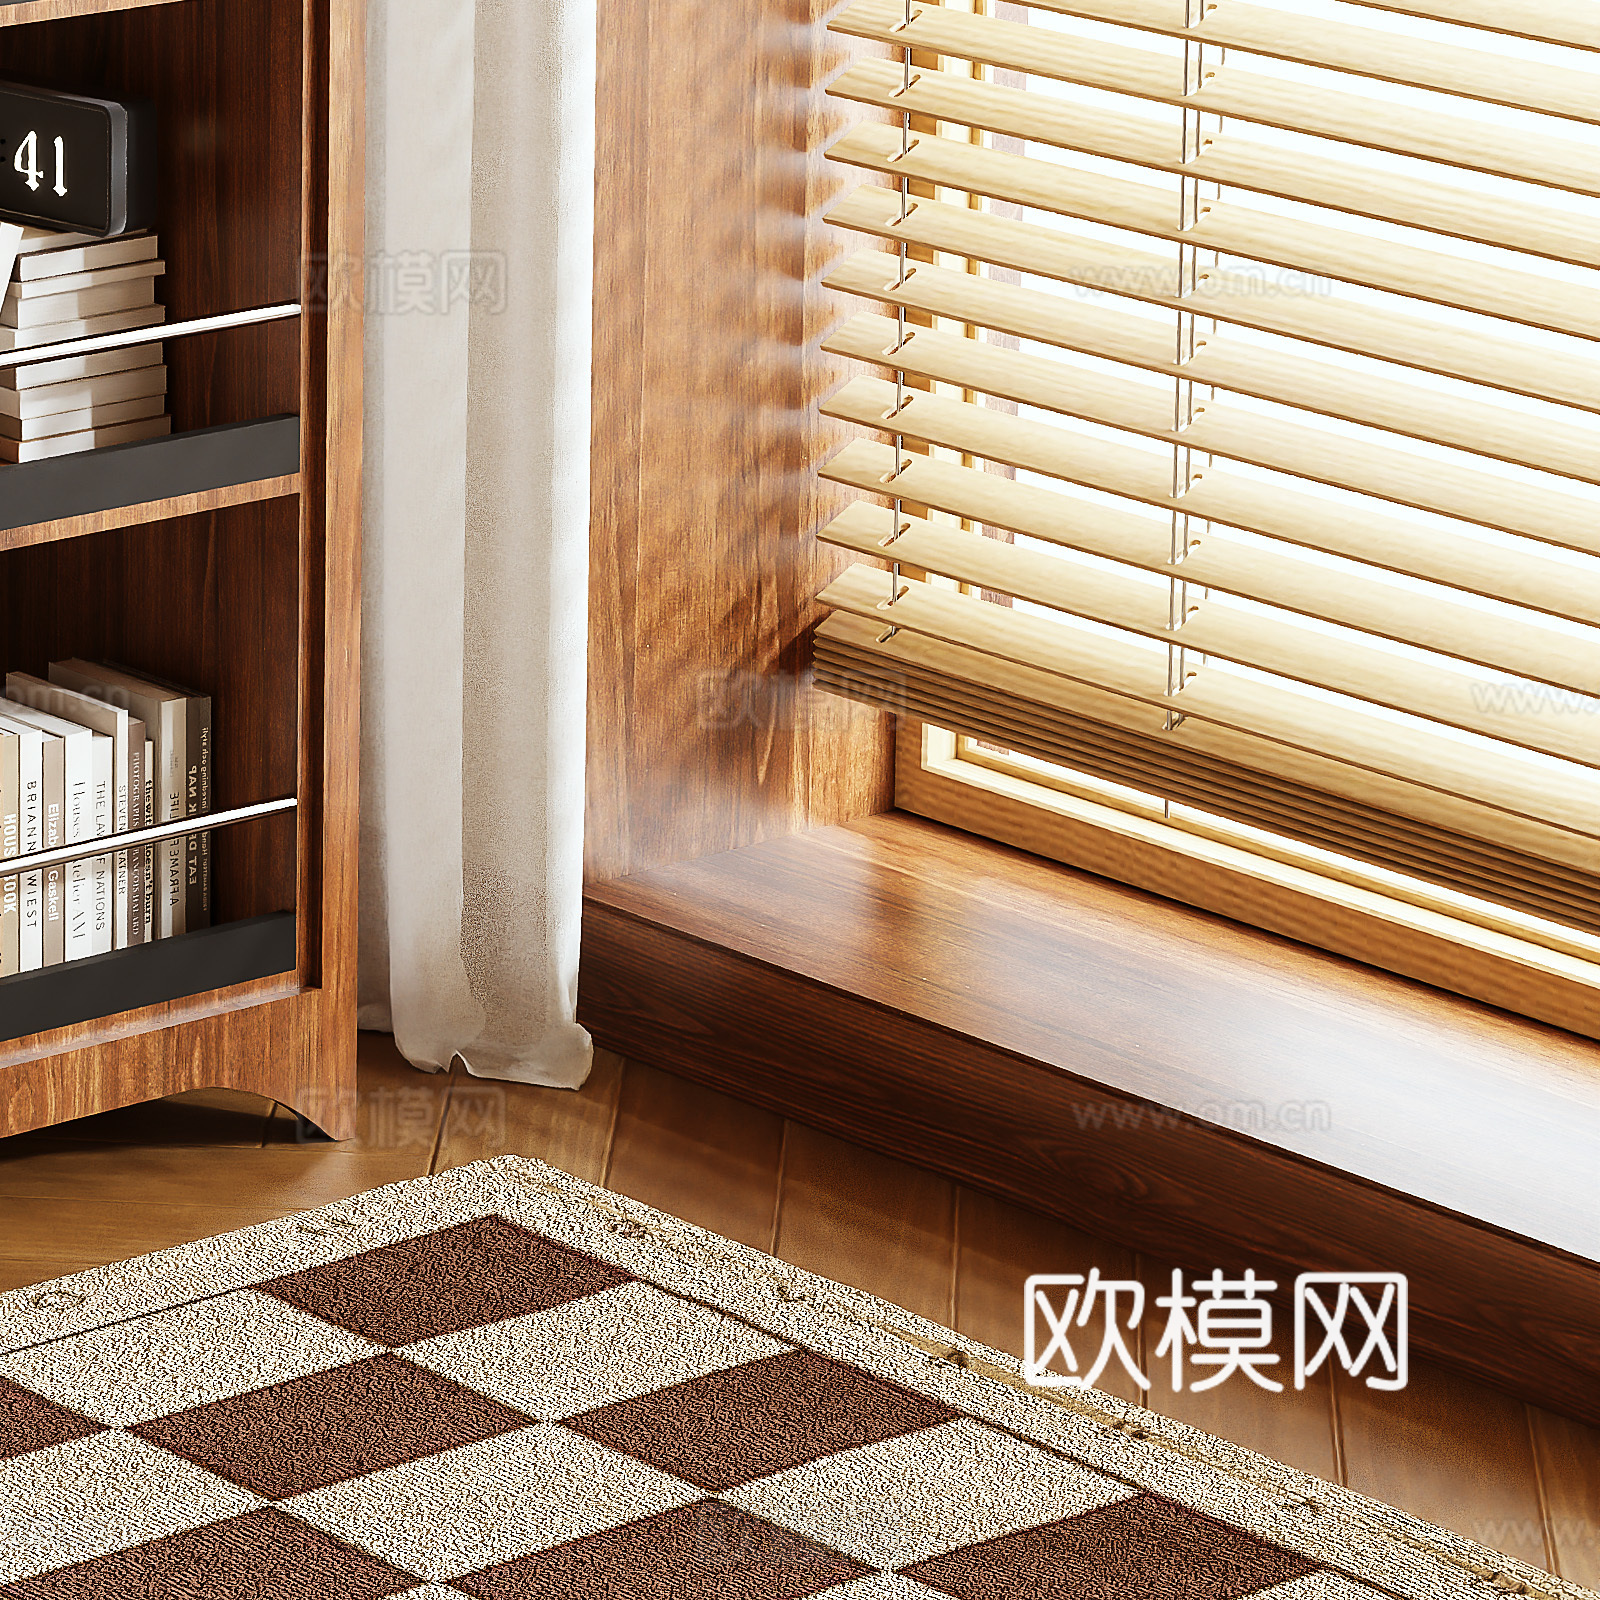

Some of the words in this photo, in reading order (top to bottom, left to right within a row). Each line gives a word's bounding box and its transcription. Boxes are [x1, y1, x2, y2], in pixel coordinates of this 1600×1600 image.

[26, 780, 37, 852] BRIANN
[96, 780, 106, 810] THE
[118, 784, 127, 830] STEVEN
[26, 874, 37, 928] WIEST
[47, 870, 60, 921] Gaskell
[95, 870, 106, 931] NATIONS
